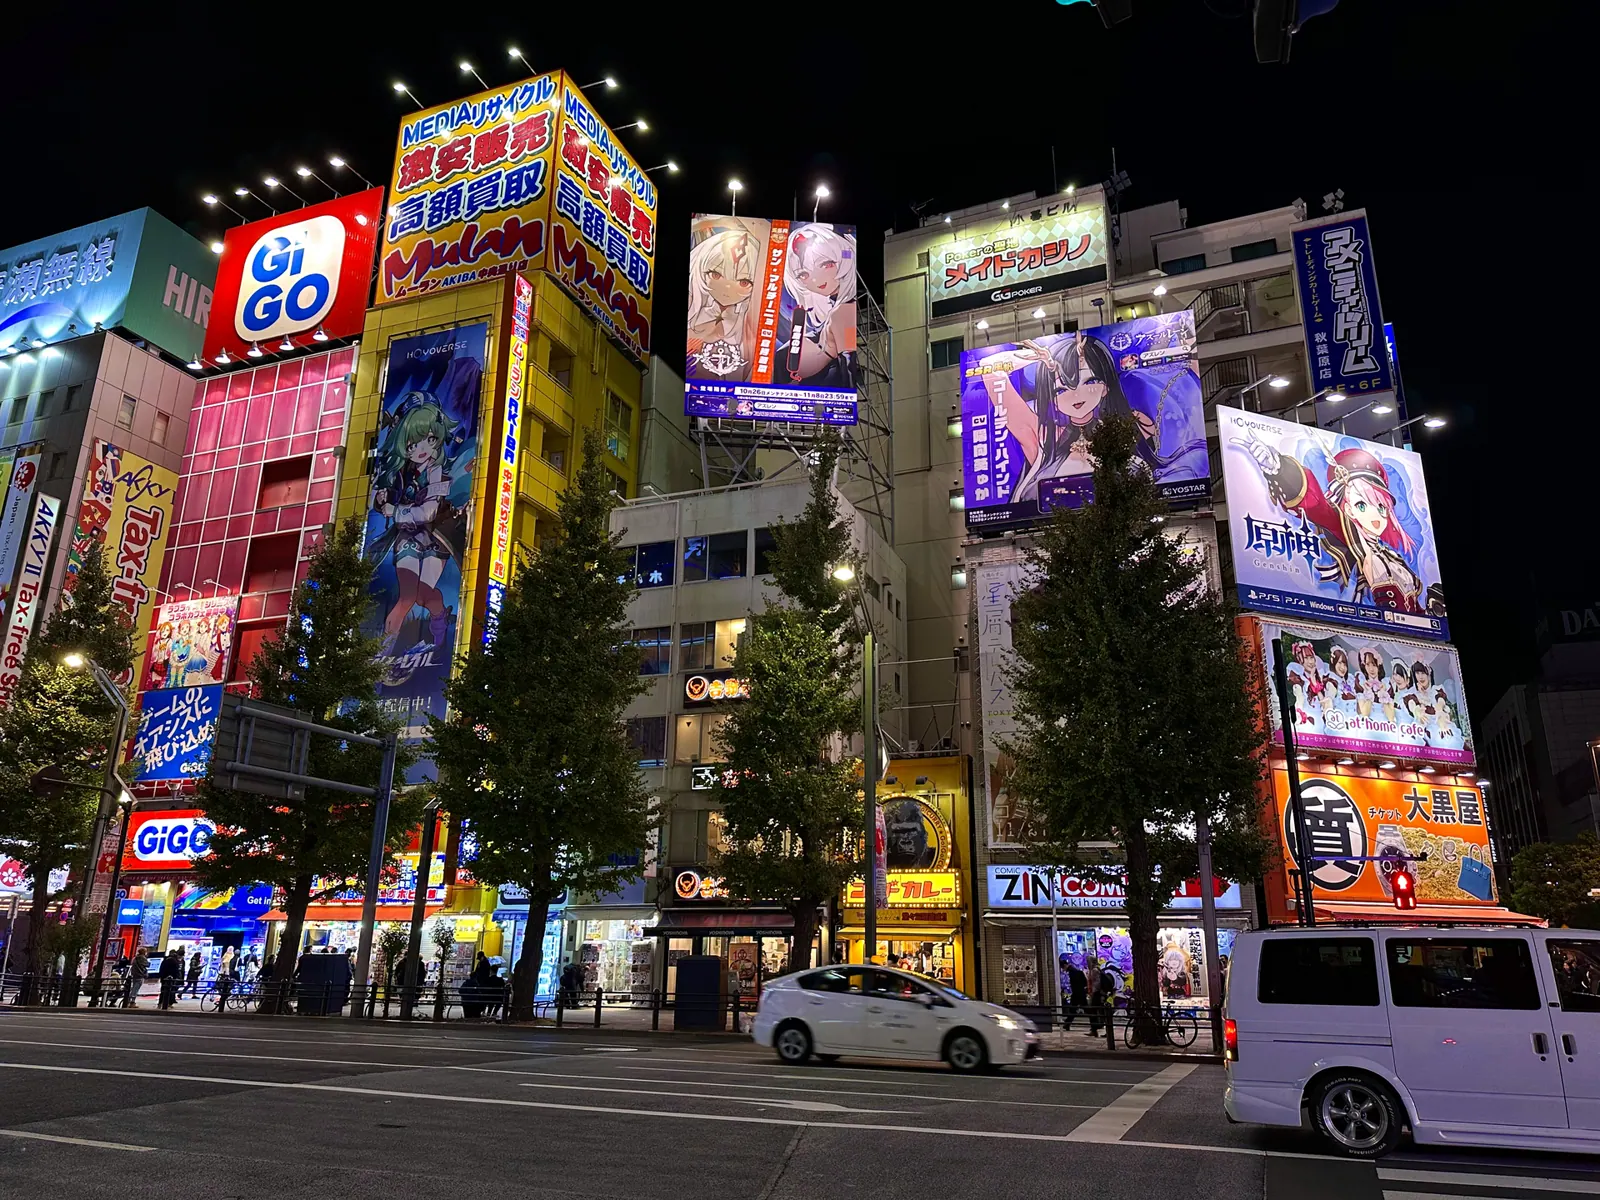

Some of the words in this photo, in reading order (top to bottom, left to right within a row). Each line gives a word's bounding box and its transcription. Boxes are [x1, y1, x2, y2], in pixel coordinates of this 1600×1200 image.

[398, 111, 551, 190] 激安販売
[388, 160, 545, 241] 高額買取
[384, 217, 546, 298] Mulan
[556, 170, 652, 300] 高額買取
[945, 233, 1092, 289] メイドカジノ
[0, 234, 116, 306] 瀬無線
[552, 222, 650, 353] Mulan
[242, 273, 330, 332] GO
[1230, 416, 1283, 436] HOYOVERSE
[30, 497, 54, 564] AKKY
[1243, 508, 1321, 582] 原神
[1253, 558, 1301, 574] Genshin
[1309, 600, 1335, 612] Windows
[1400, 723, 1424, 737] cafe
[1368, 805, 1402, 820] チケット
[1403, 787, 1483, 827] 大黒屋
[995, 871, 1052, 906] ZIN
